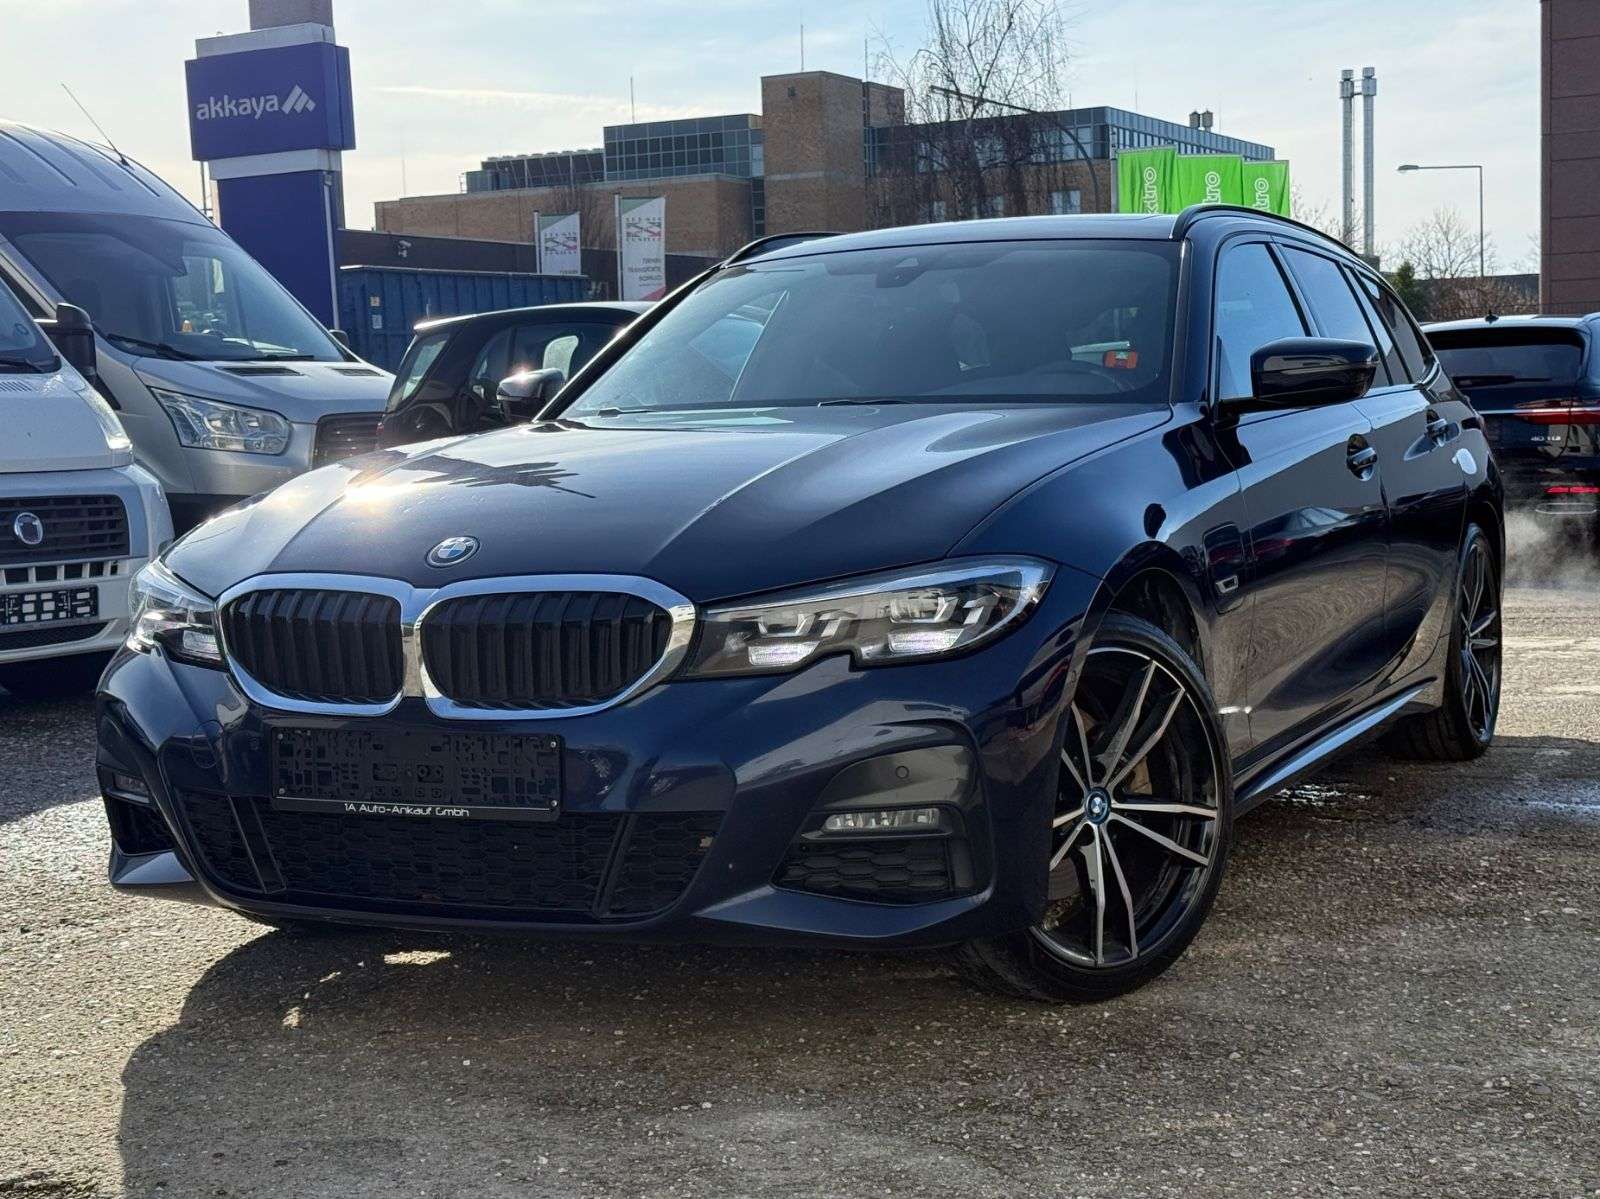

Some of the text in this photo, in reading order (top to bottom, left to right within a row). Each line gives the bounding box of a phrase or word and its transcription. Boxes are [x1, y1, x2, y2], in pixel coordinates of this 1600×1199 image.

[196, 94, 279, 120] akkaya
[344, 803, 470, 817] 1A Auto-Ankauf Gmbh
